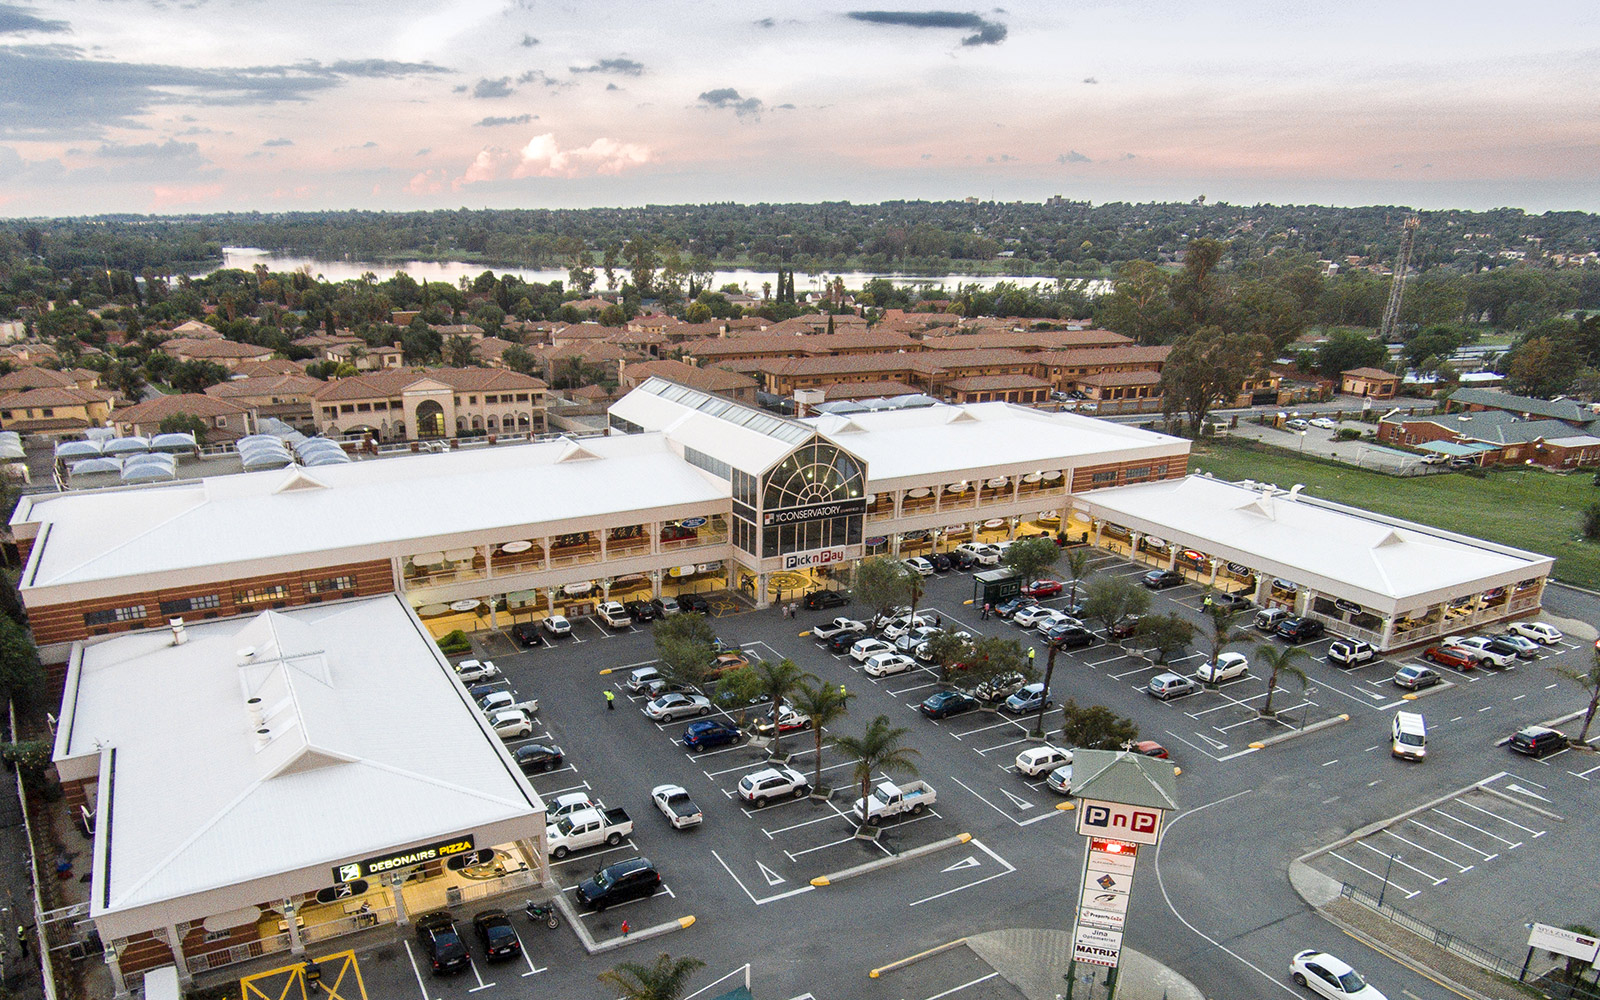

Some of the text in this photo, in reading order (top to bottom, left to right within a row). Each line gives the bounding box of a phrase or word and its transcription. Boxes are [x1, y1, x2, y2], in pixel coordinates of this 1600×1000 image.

[780, 506, 841, 522] CONSERVATORY
[787, 550, 844, 569] Pick n Pay
[369, 841, 472, 873] DEBONAIRS PIZZA
[1092, 929, 1108, 937] Jina
[1076, 945, 1118, 958] MATRIX
